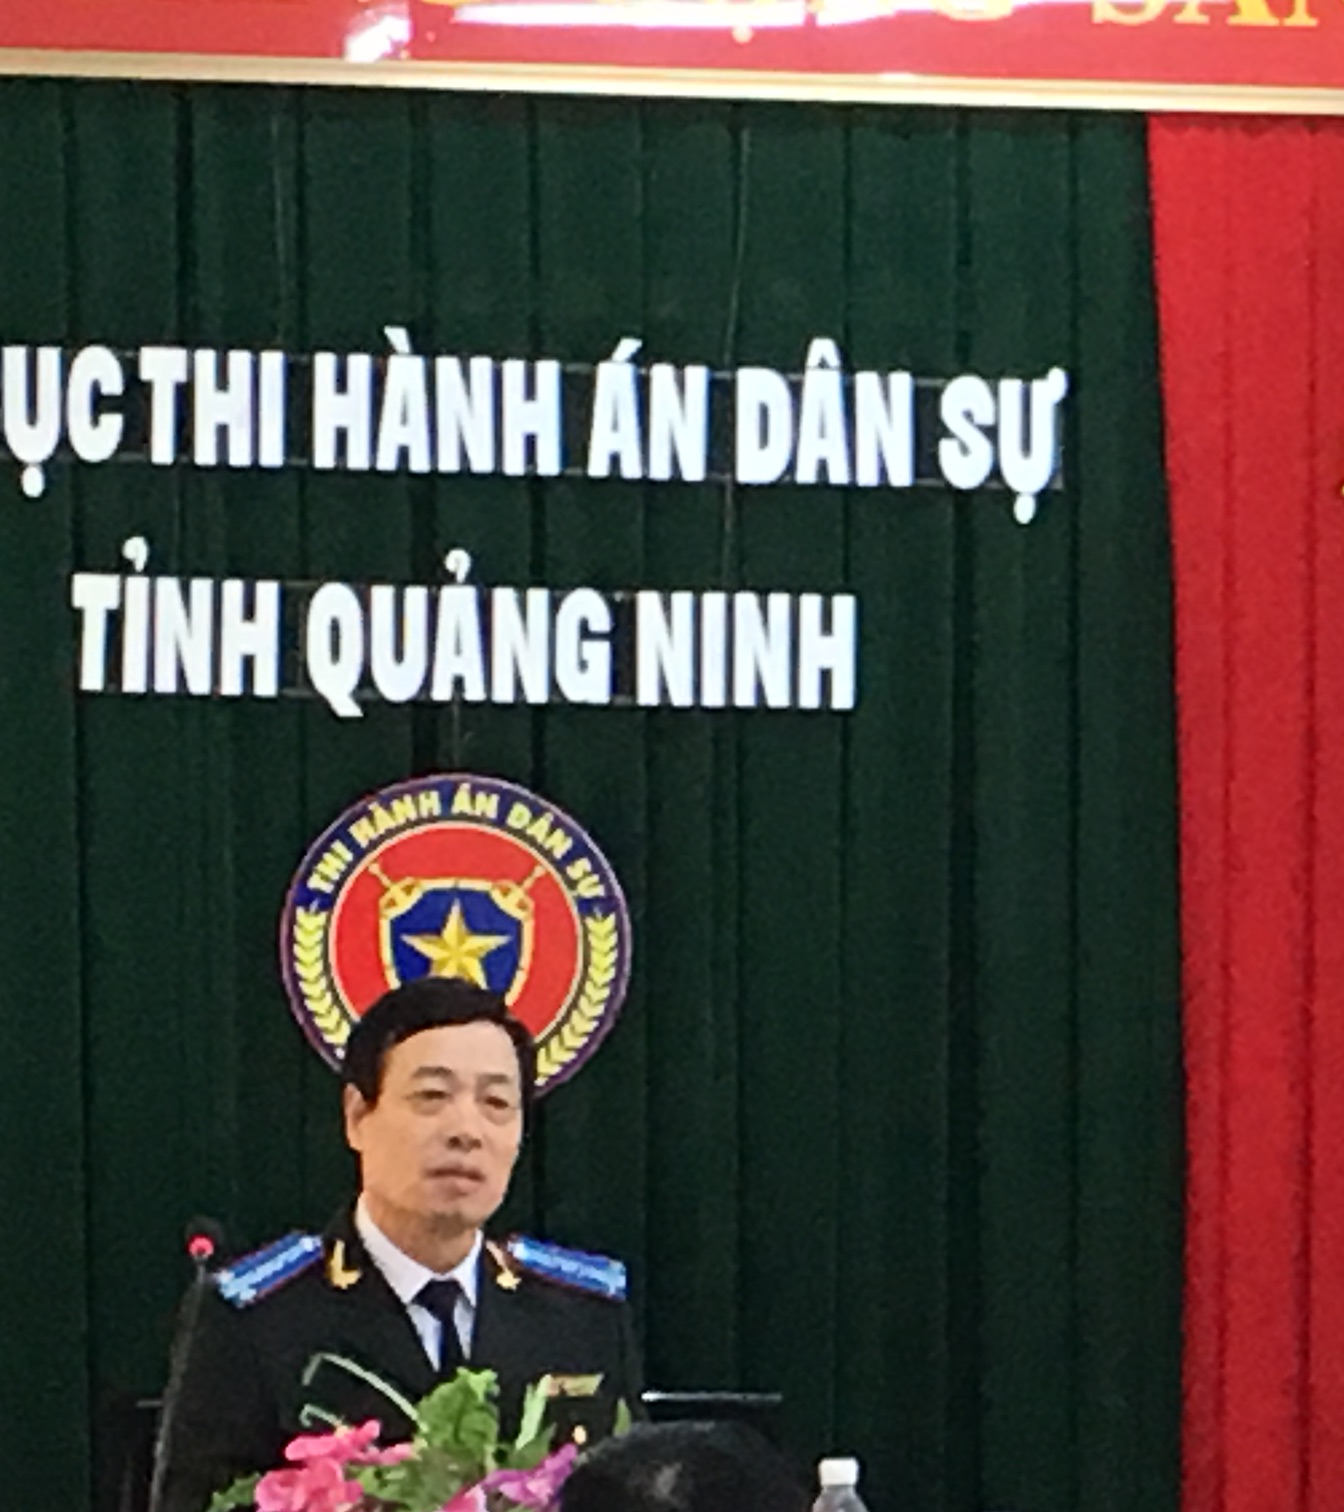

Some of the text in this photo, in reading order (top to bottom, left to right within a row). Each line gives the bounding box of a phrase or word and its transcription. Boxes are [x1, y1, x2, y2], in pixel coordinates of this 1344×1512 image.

[139, 346, 284, 467] THI
[313, 326, 561, 476] HÀNH
[587, 338, 708, 482] ÁN
[735, 337, 913, 487] DÂN
[938, 367, 1067, 524] SỰ
[72, 536, 856, 717] TỈNH QUẢNG NINH
[306, 842, 354, 894] THI
[347, 790, 441, 847] HÀNH
[451, 782, 499, 820] ÁN
